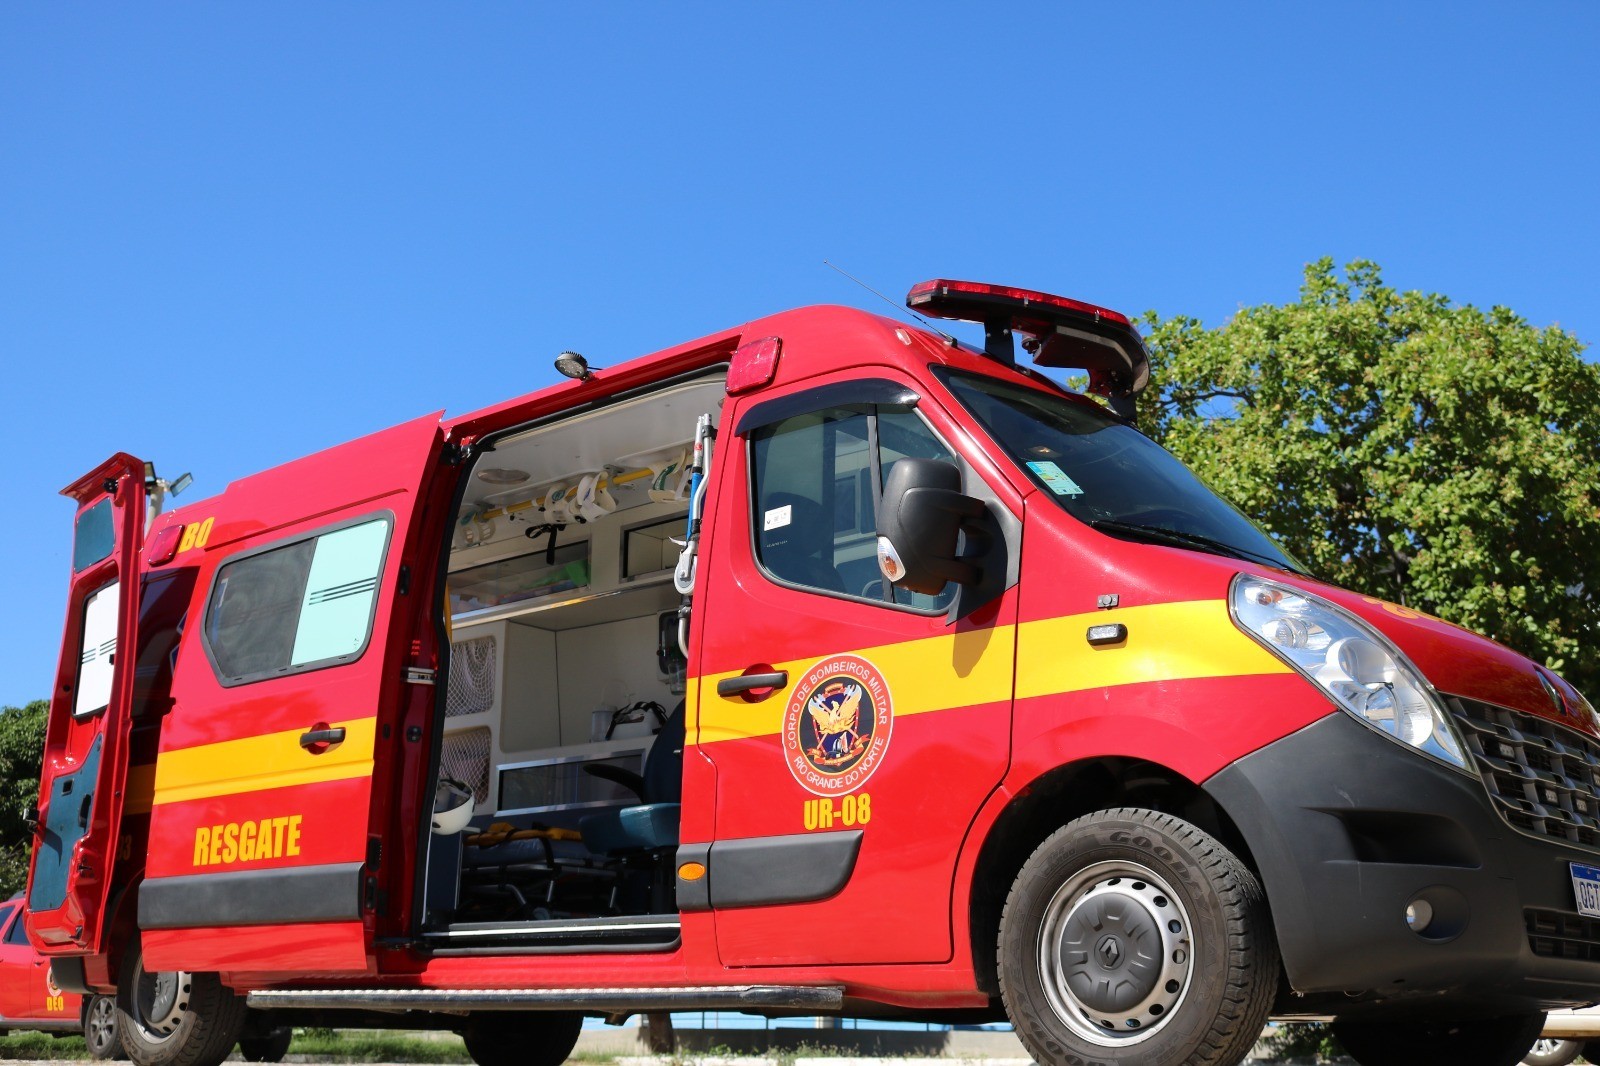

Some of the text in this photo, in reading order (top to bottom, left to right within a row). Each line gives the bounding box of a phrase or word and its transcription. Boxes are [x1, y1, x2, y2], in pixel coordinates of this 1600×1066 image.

[177, 516, 215, 554] BO
[788, 661, 888, 749] CORPO DE BOMBEIROS MILITAR
[794, 756, 808, 775] RIO
[807, 772, 844, 789] GRANDE
[845, 771, 859, 785] DO
[860, 736, 884, 774] NORTE
[804, 793, 871, 830] UR-08
[193, 815, 302, 866] RESGATE
[46, 995, 64, 1011] DEO
